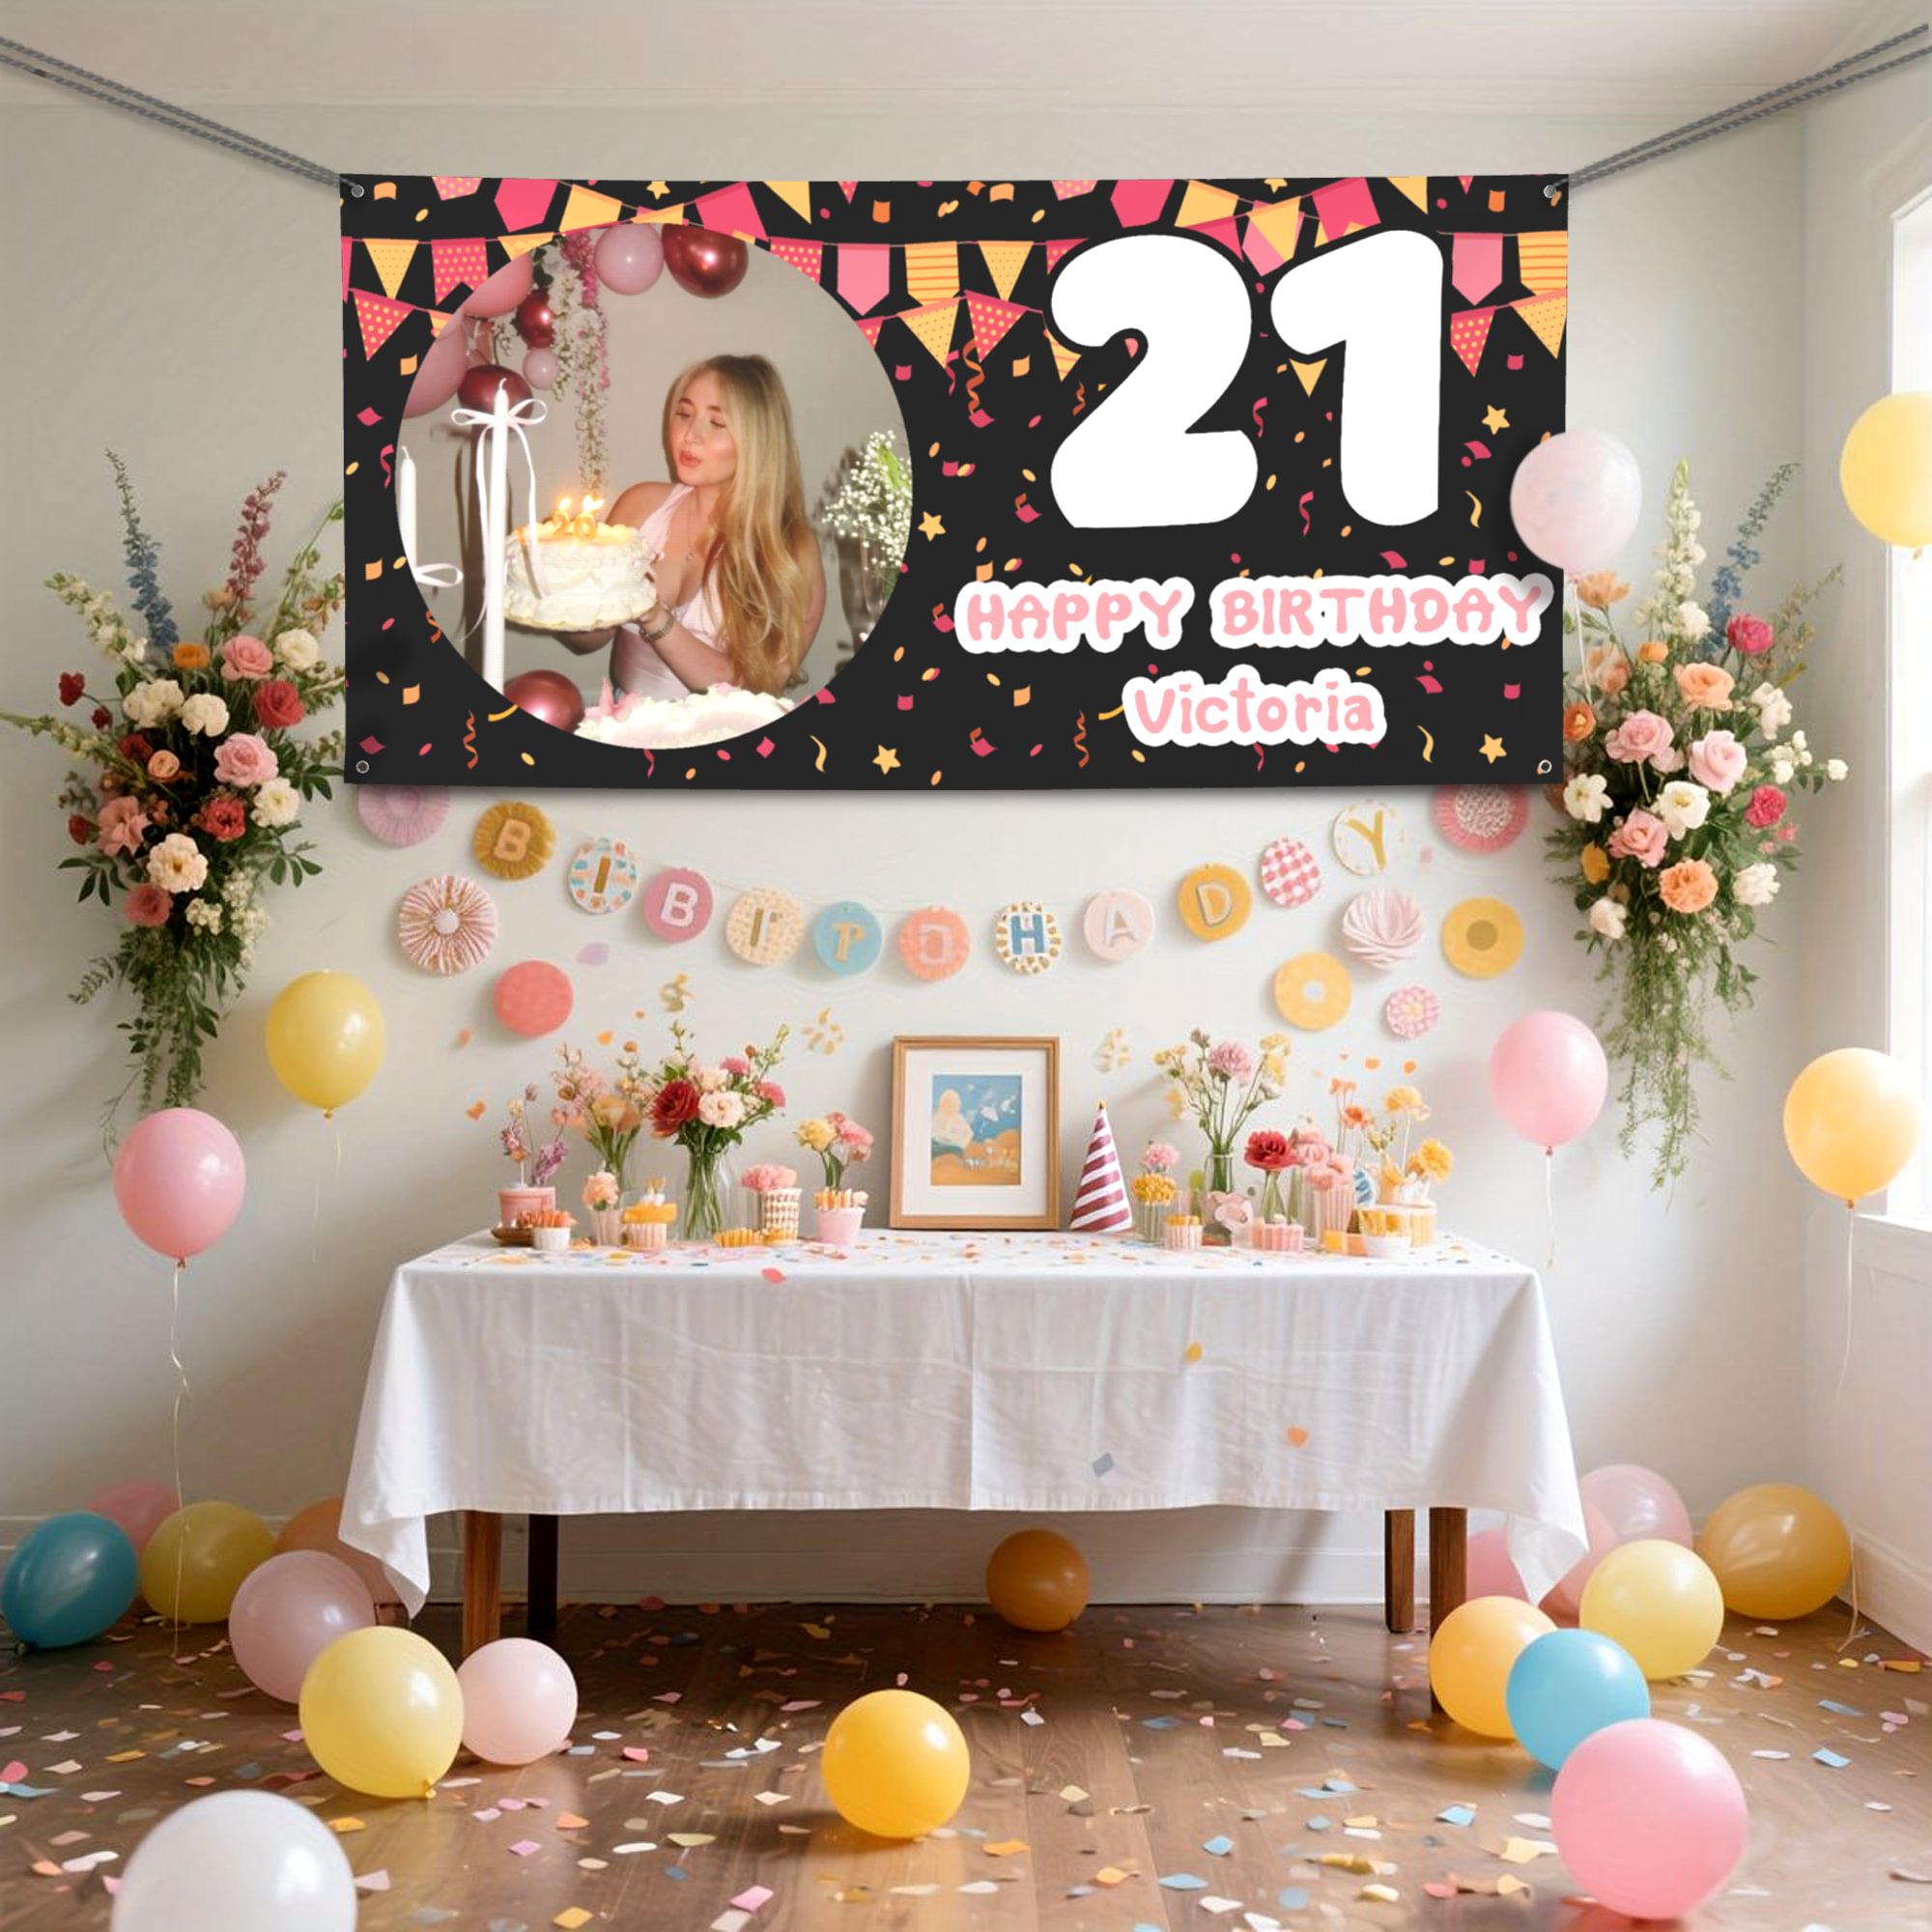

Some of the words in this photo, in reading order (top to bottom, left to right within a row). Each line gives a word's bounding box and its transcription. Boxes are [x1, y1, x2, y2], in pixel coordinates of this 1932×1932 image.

[1051, 230, 1444, 527] 21
[967, 589, 1182, 641] HAPPY
[1222, 585, 1543, 637] BIRTHDAY
[1134, 677, 1376, 733] Victoria
